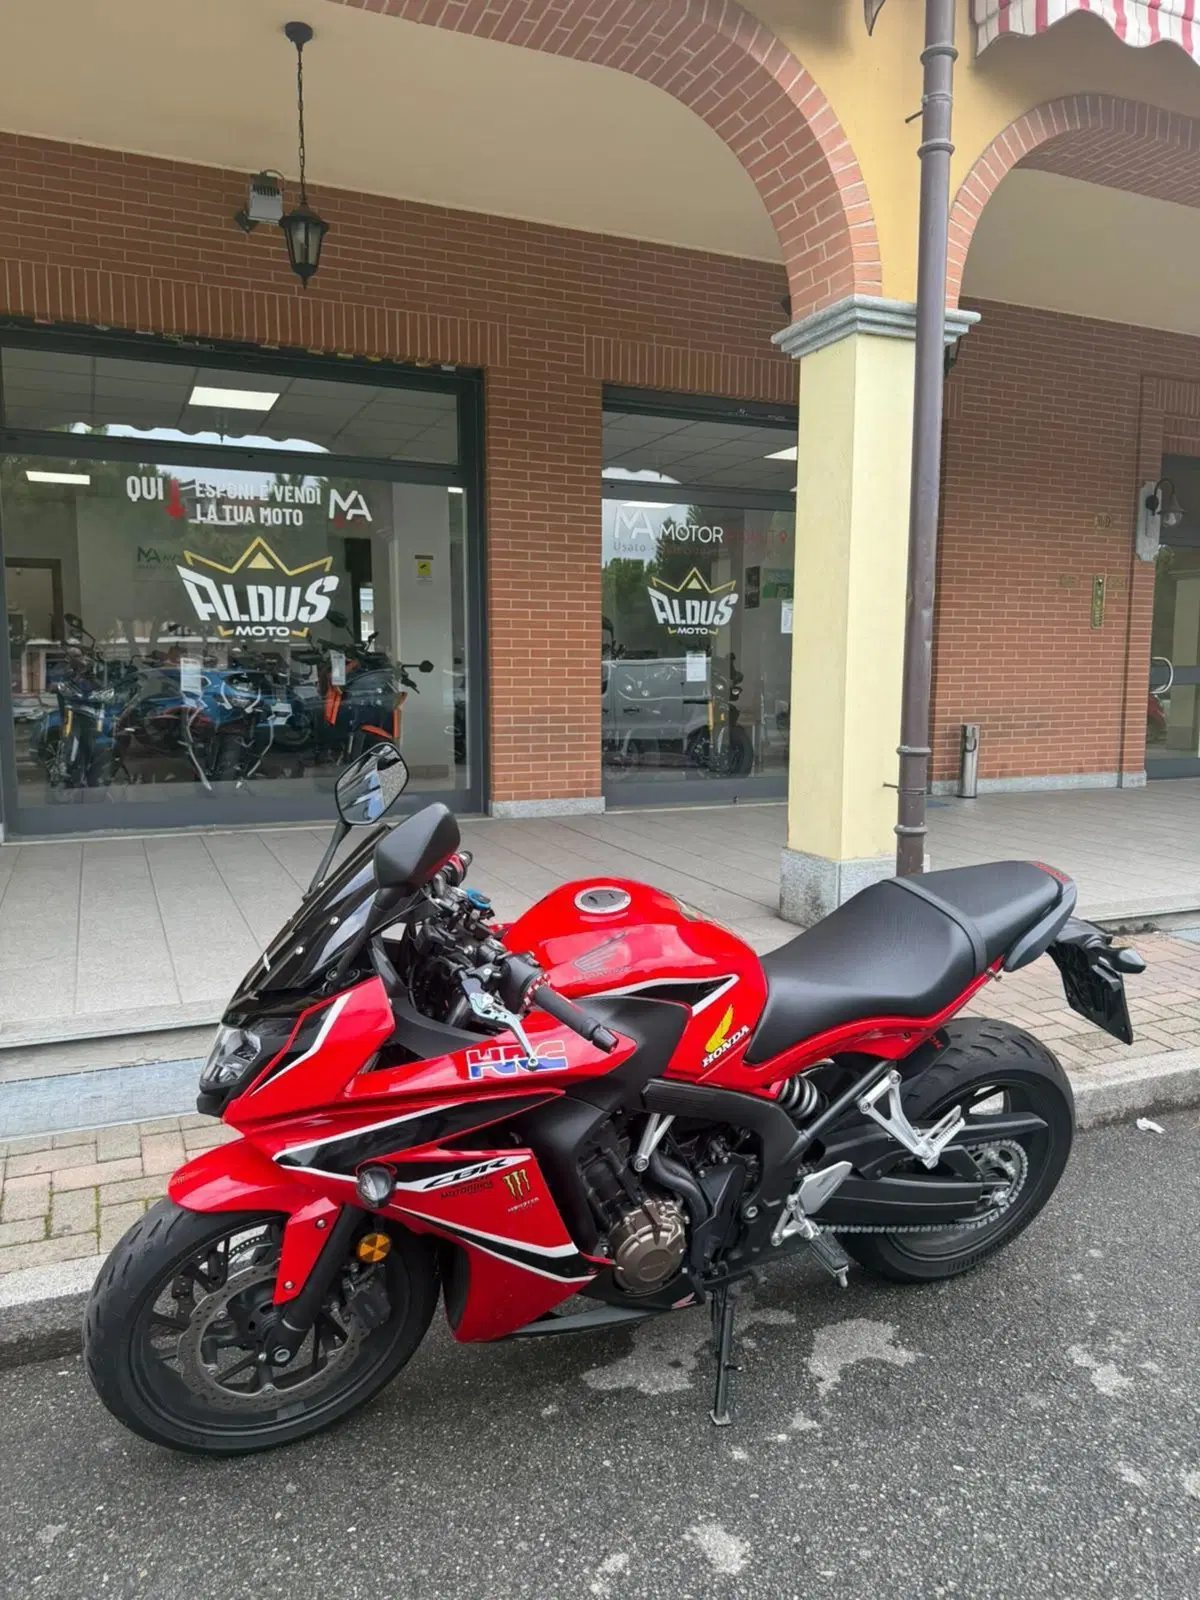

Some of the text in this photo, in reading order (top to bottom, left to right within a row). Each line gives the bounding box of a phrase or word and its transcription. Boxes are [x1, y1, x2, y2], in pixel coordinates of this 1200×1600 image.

[126, 475, 164, 502] QUI
[195, 482, 322, 504] ESPONI E VENDI
[196, 503, 303, 526] LA TUA MOTO
[660, 524, 724, 544] MOTOR
[176, 564, 340, 623] ALDUS
[647, 586, 739, 626] ALDUS
[235, 626, 290, 637] MOTO
[677, 626, 709, 635] MOTO
[702, 1025, 750, 1068] HONDA
[423, 1158, 509, 1188] CBR
